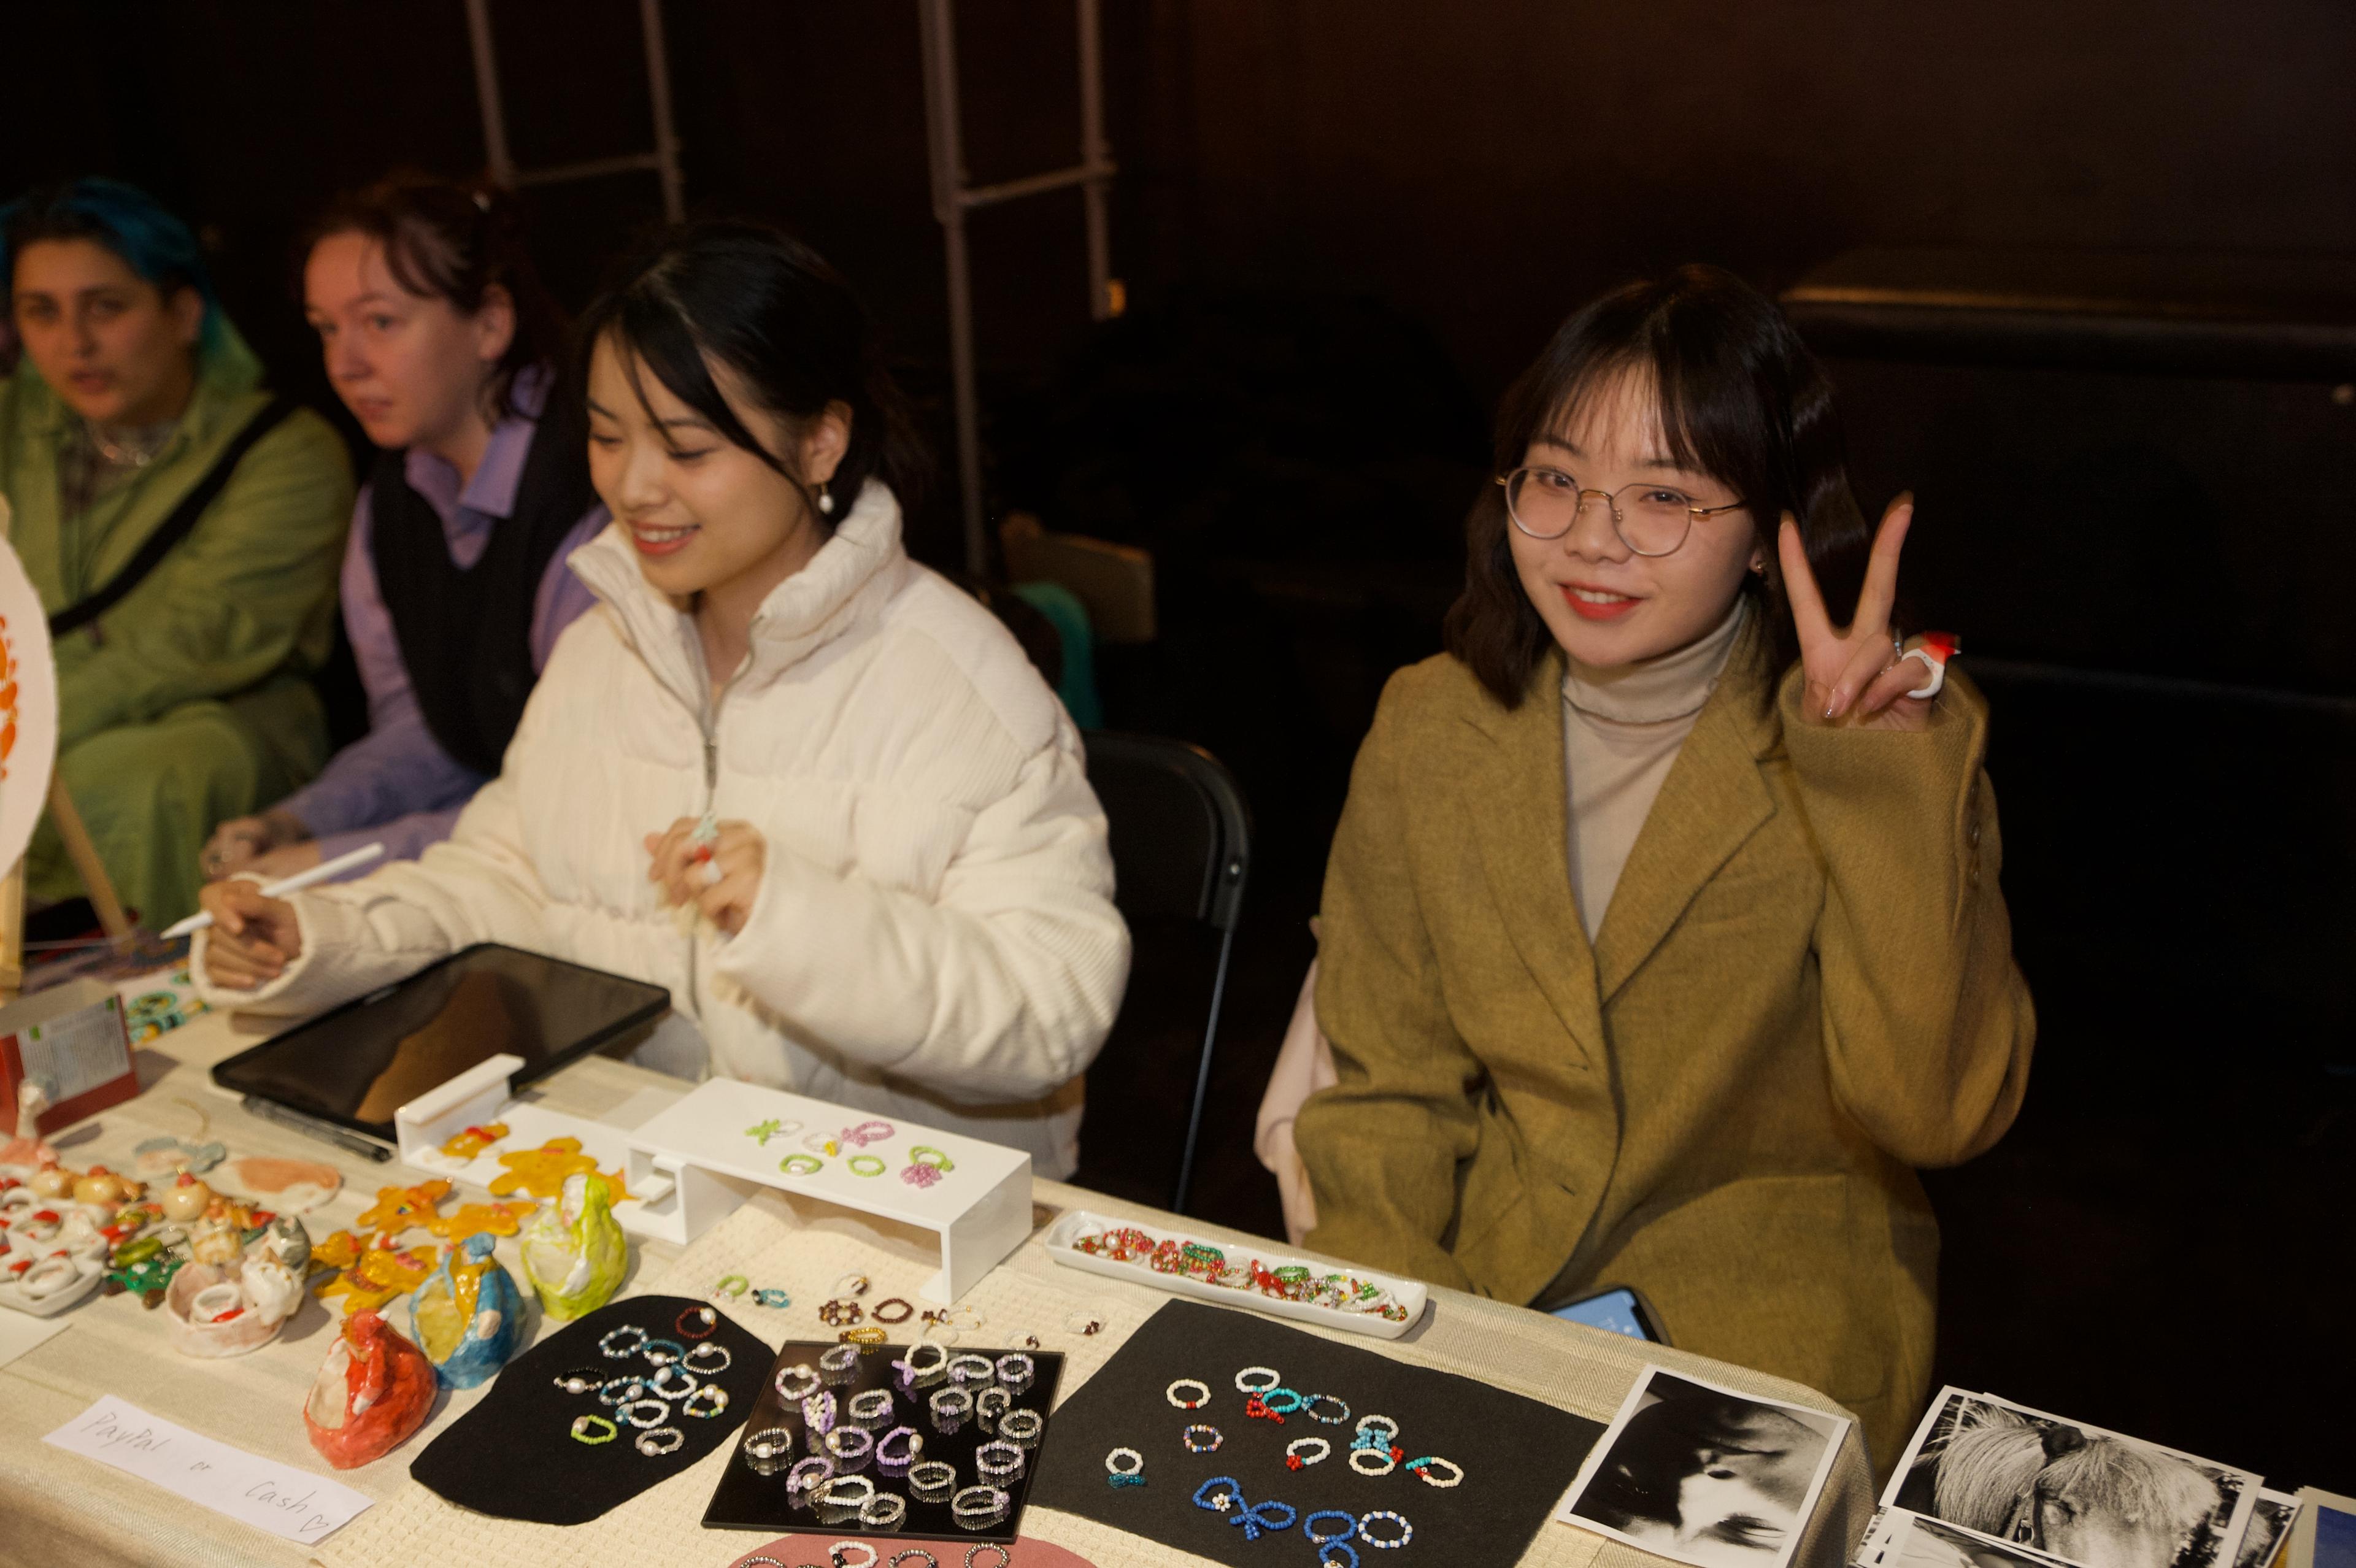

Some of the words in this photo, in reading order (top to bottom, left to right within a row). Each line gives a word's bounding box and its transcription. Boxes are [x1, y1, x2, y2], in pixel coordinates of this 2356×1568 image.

[80, 1412, 171, 1451] PayPal
[189, 1461, 210, 1470] or
[245, 1480, 317, 1513] Cash
